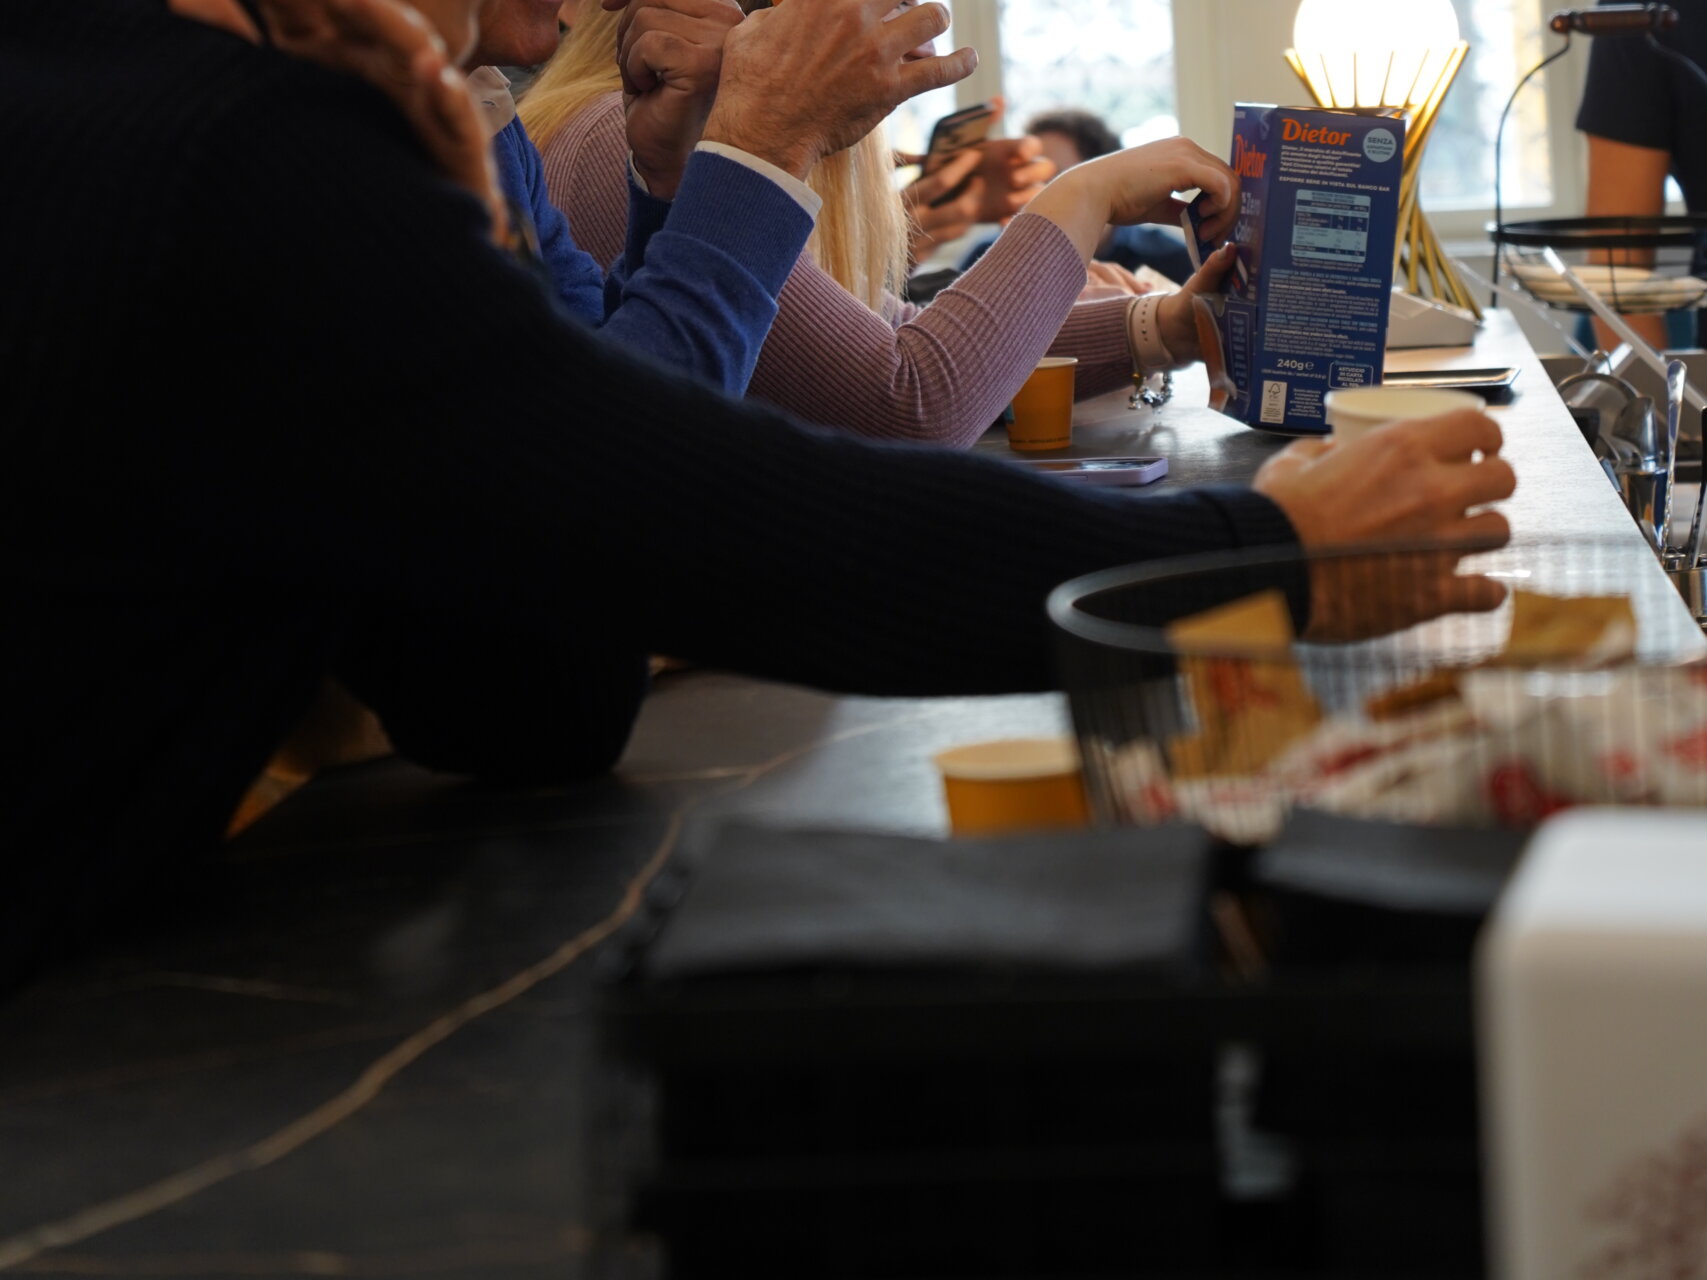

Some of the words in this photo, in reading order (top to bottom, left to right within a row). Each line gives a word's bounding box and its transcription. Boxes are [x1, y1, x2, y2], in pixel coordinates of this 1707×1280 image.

[1281, 119, 1351, 146] Dietor
[1367, 136, 1393, 145] SENZA
[1235, 134, 1266, 178] Dietor
[1276, 358, 1304, 371] 240g
